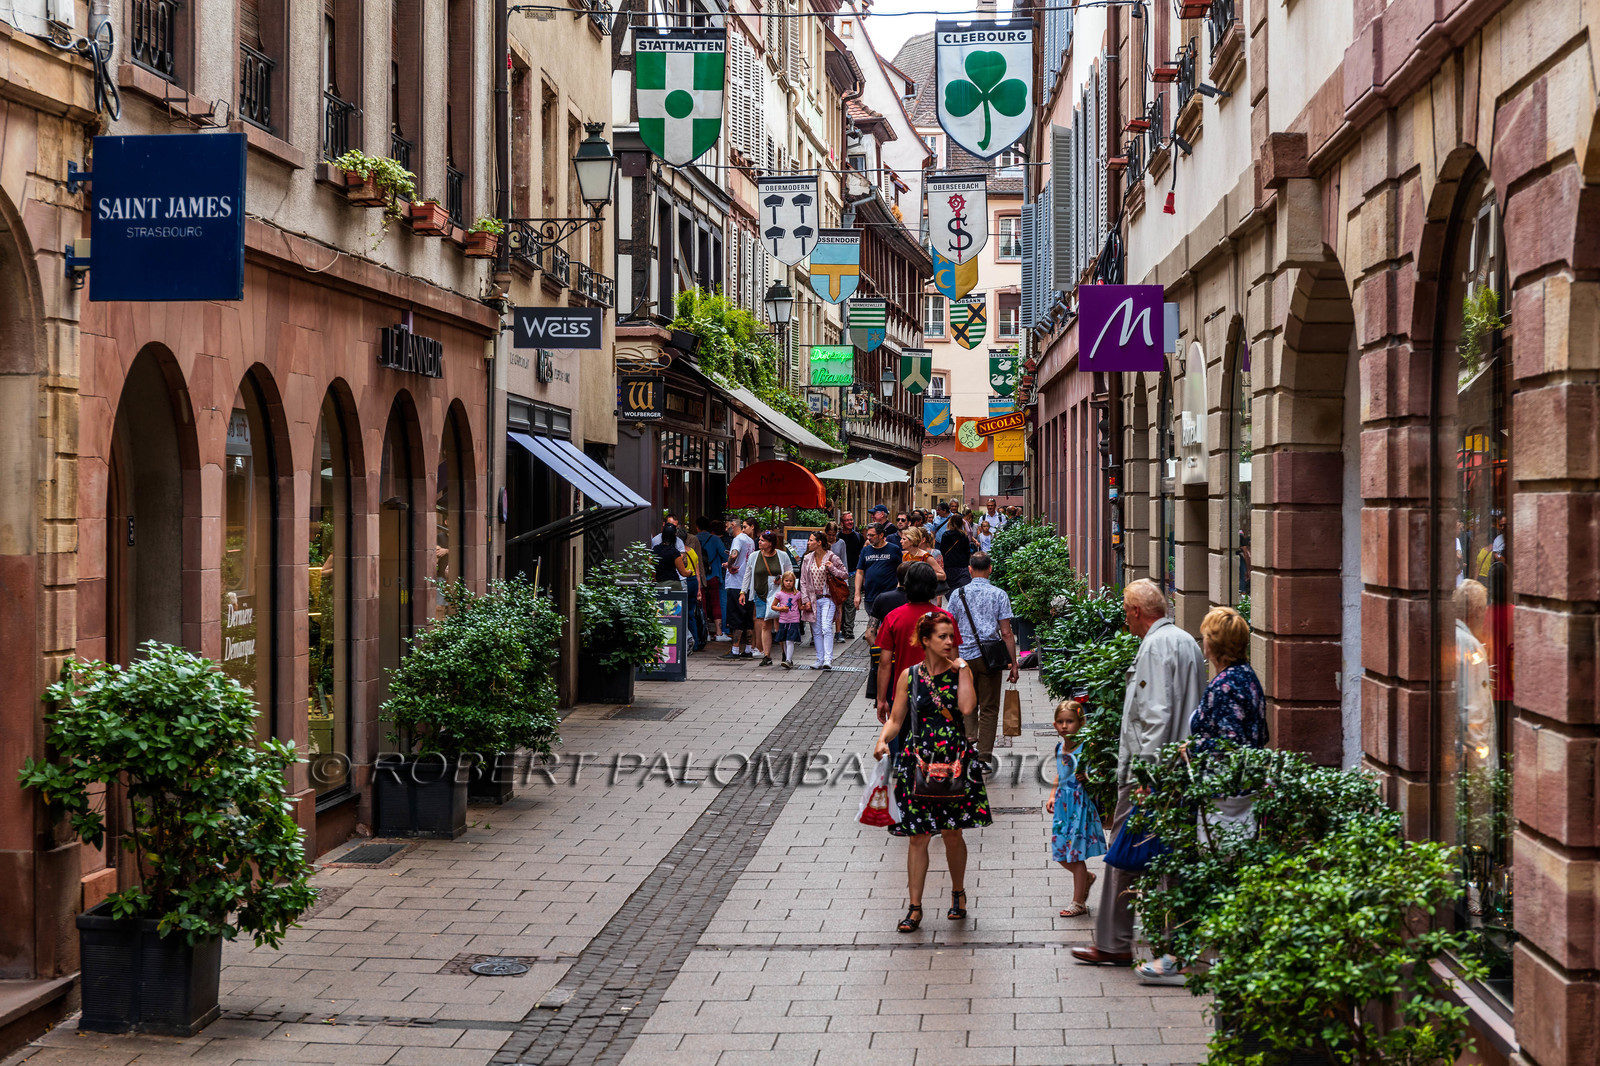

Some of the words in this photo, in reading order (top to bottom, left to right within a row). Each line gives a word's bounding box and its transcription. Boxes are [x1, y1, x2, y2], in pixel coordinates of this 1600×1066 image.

[943, 31, 1027, 43] CLEEBOURG
[638, 40, 723, 51] STATTMATTEN
[765, 184, 810, 192] OBERMODERN
[933, 183, 979, 191] OBERSEEBACH
[98, 197, 162, 220] SAINT
[165, 196, 232, 219] JAMES
[126, 226, 203, 238] STRASBOURG
[522, 316, 593, 338] Weiss
[961, 423, 970, 432] LE
[978, 415, 1022, 432] NICOLAS
[966, 434, 980, 448] D'O
